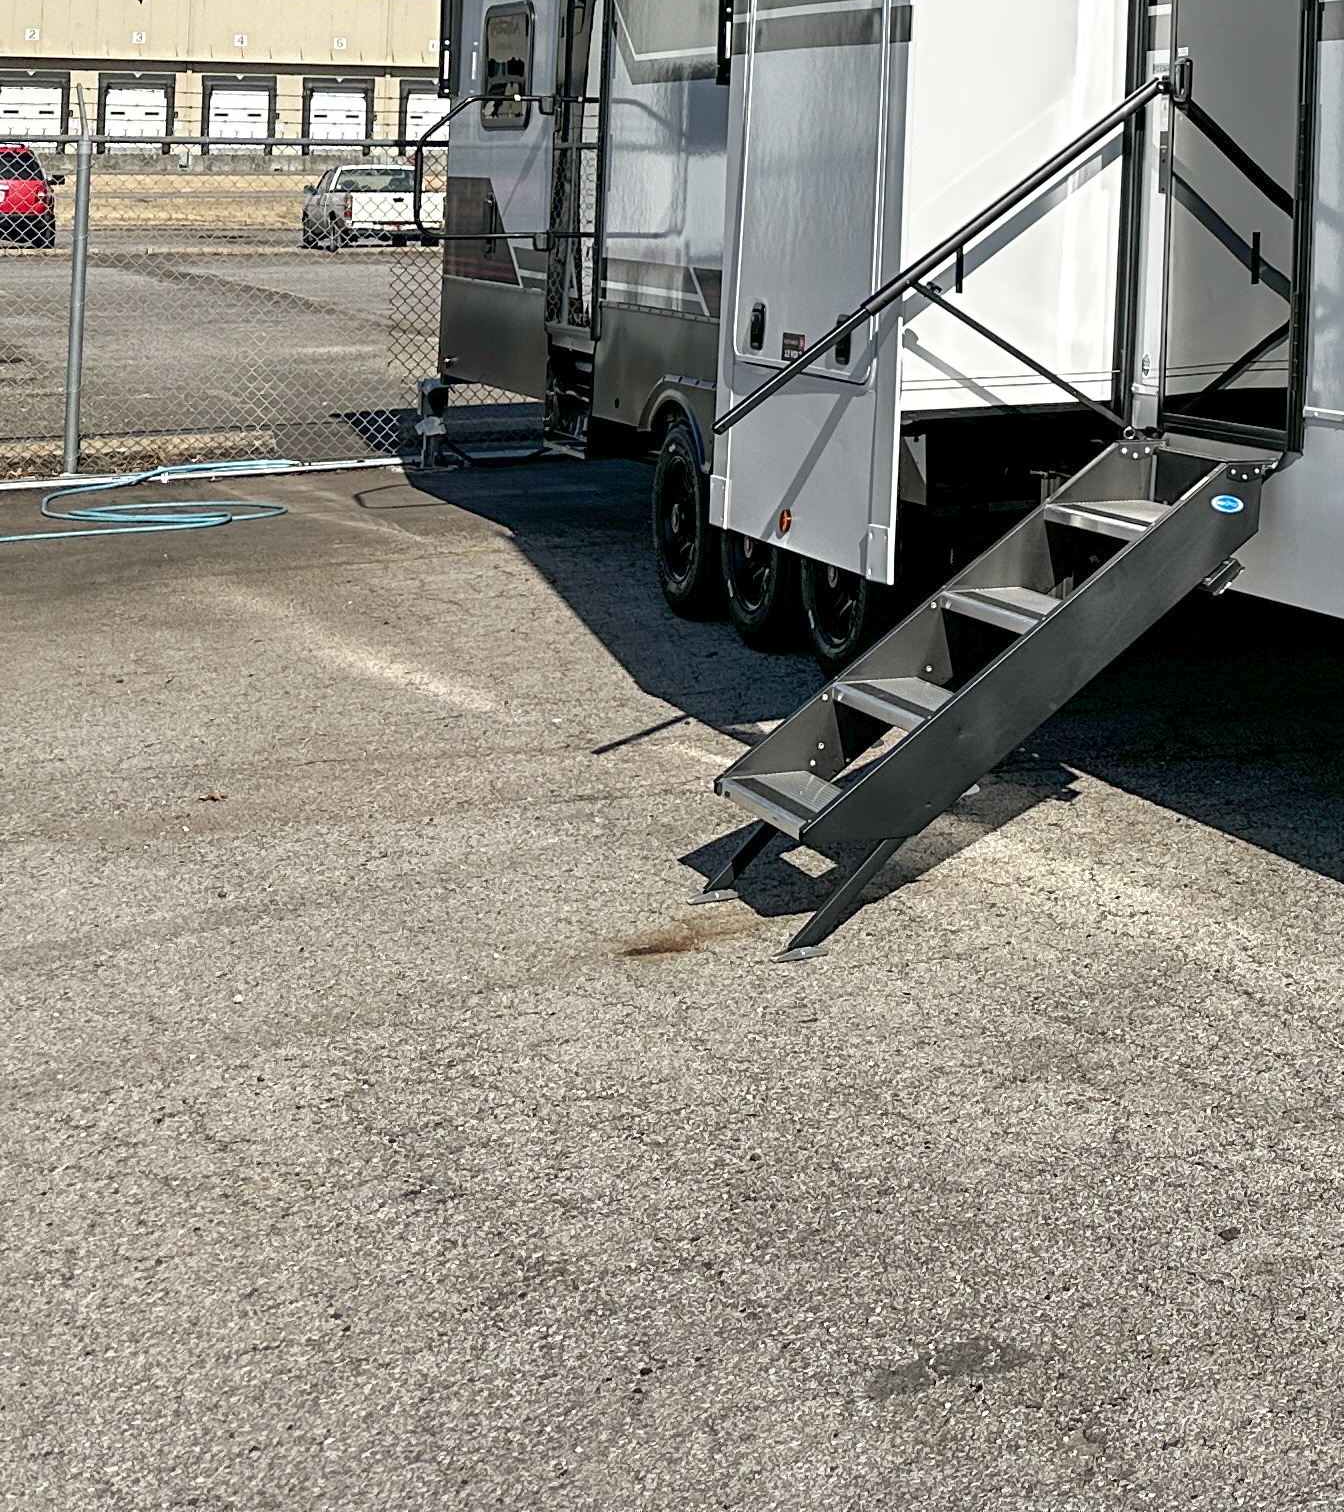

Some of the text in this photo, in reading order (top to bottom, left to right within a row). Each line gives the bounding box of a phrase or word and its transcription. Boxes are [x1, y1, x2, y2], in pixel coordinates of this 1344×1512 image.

[28, 29, 36, 40] 2
[136, 32, 143, 43] 3
[237, 35, 244, 46] 4
